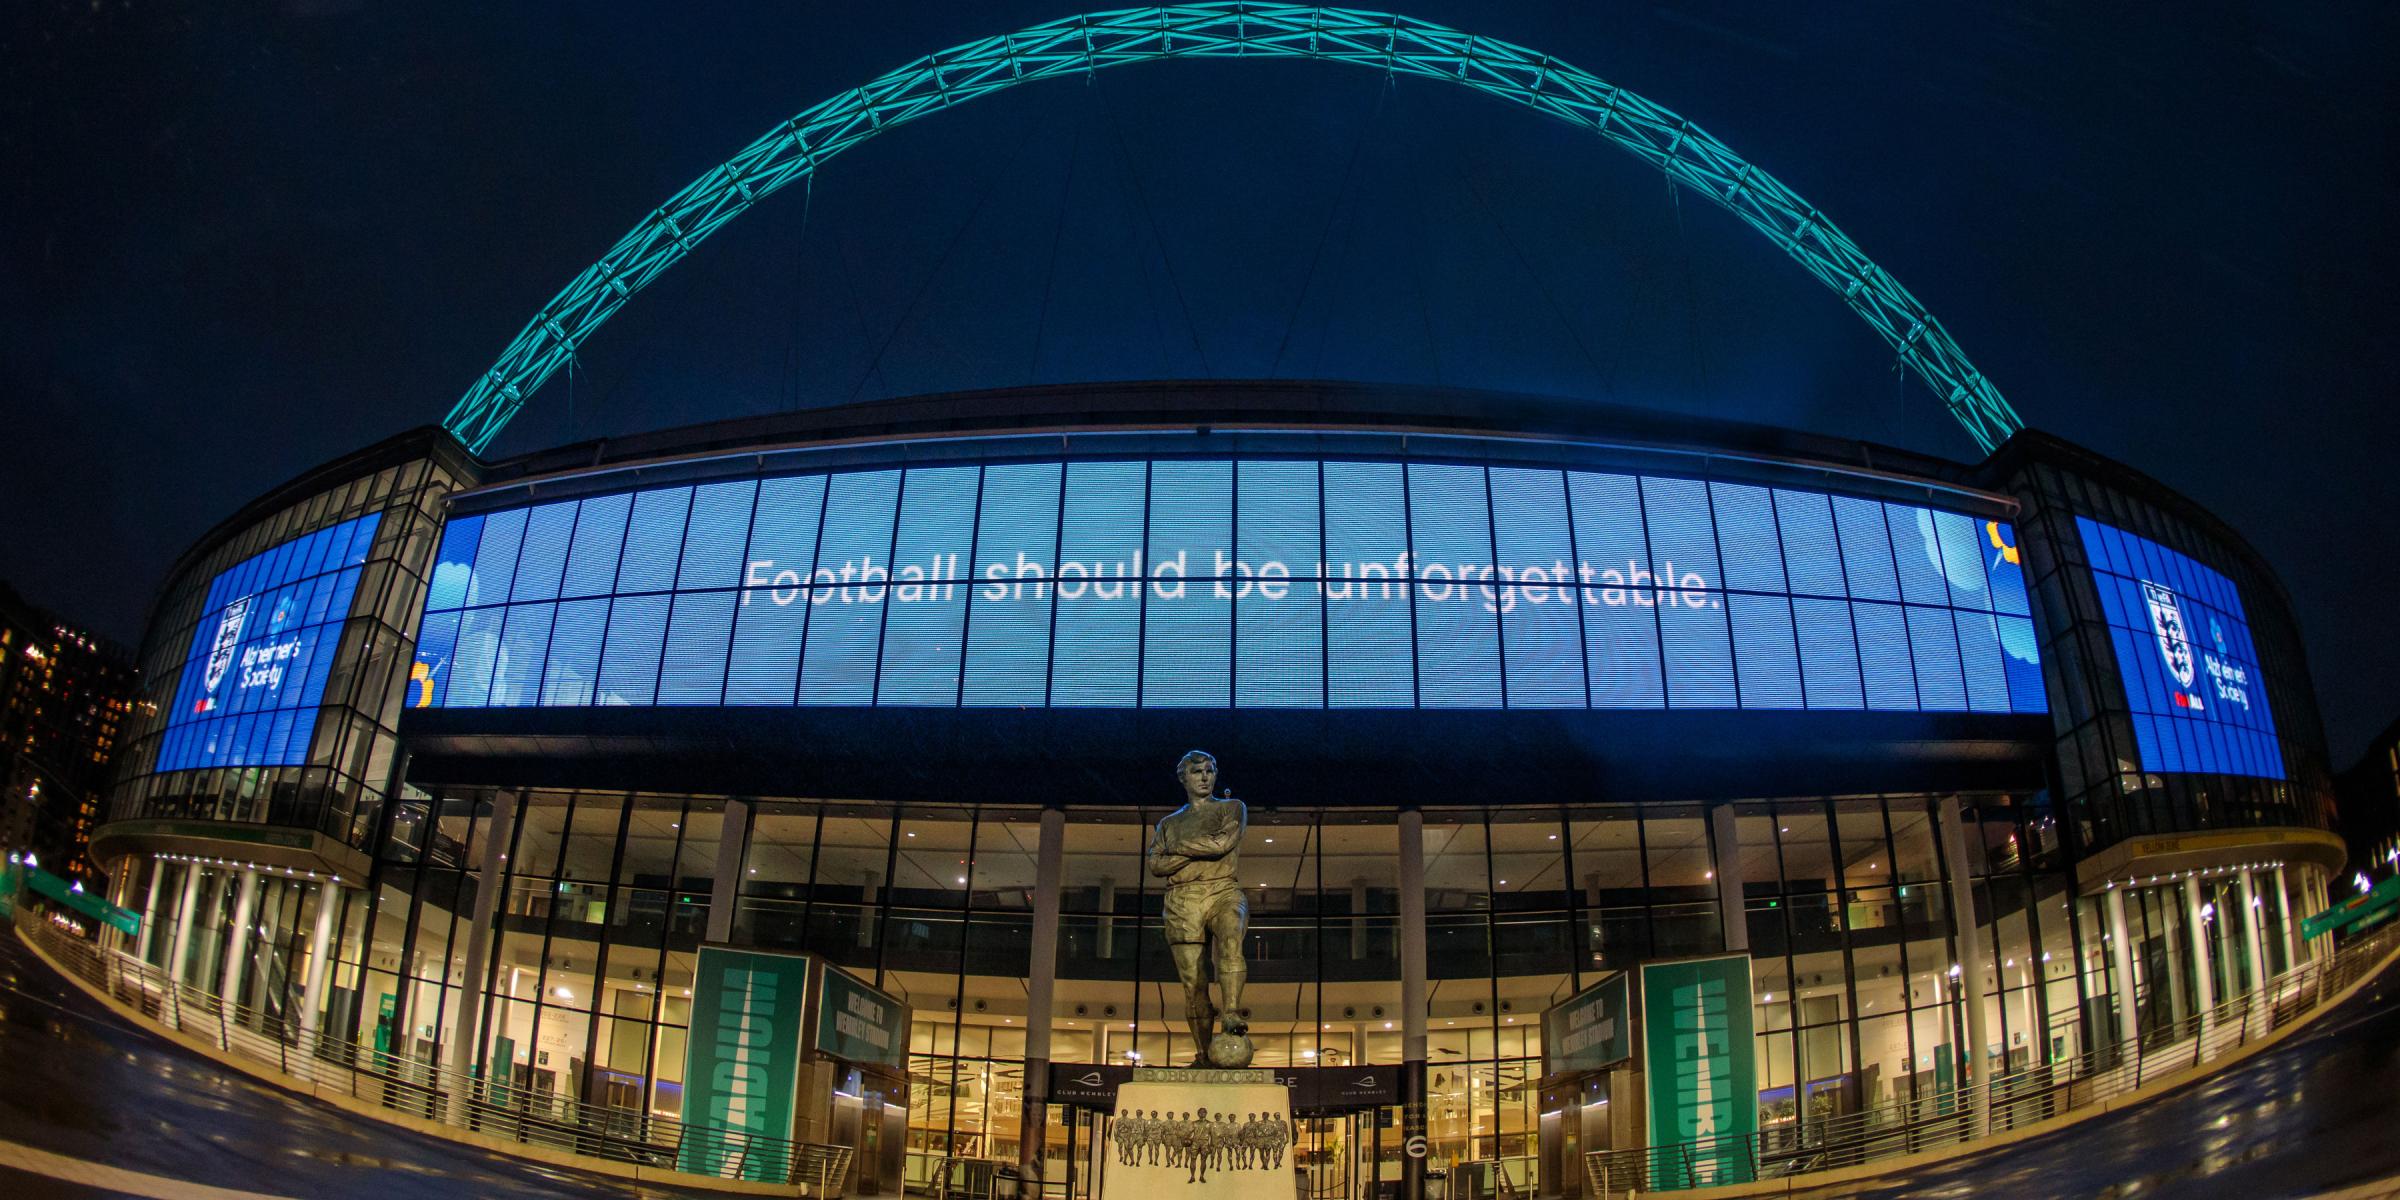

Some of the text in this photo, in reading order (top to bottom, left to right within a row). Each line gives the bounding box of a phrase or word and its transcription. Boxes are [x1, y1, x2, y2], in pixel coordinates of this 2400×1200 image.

[742, 549, 1720, 614] Football should be unforgettable.
[1142, 1070, 1264, 1083] BOBBY MOORE
